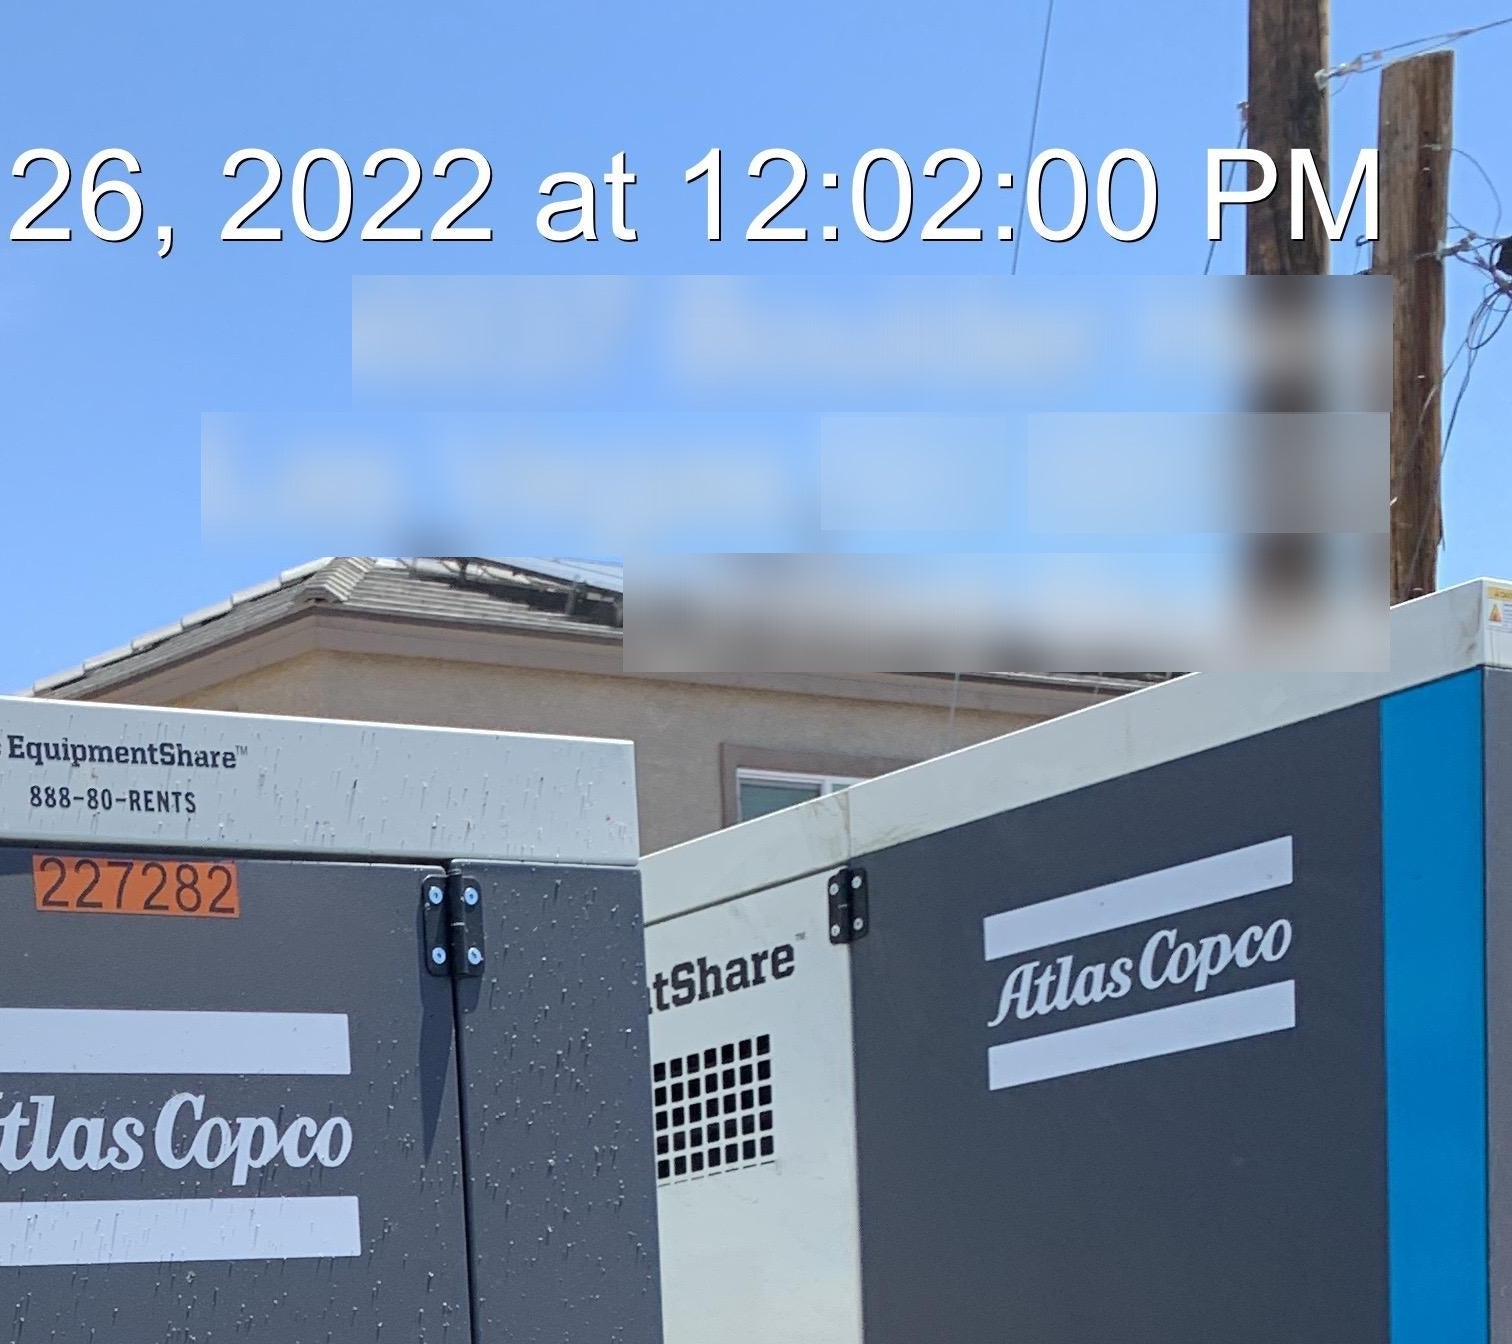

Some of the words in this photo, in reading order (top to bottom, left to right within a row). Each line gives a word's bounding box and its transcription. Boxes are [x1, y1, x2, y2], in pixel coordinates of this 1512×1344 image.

[6, 733, 238, 769] EquipmentShare
[29, 785, 197, 814] 888-80-RENTS
[39, 856, 236, 915] 227282
[648, 943, 796, 1015] tShare
[986, 955, 1134, 1028] Atlas
[1139, 918, 1293, 993] Copco
[154, 1092, 353, 1186] Copco
